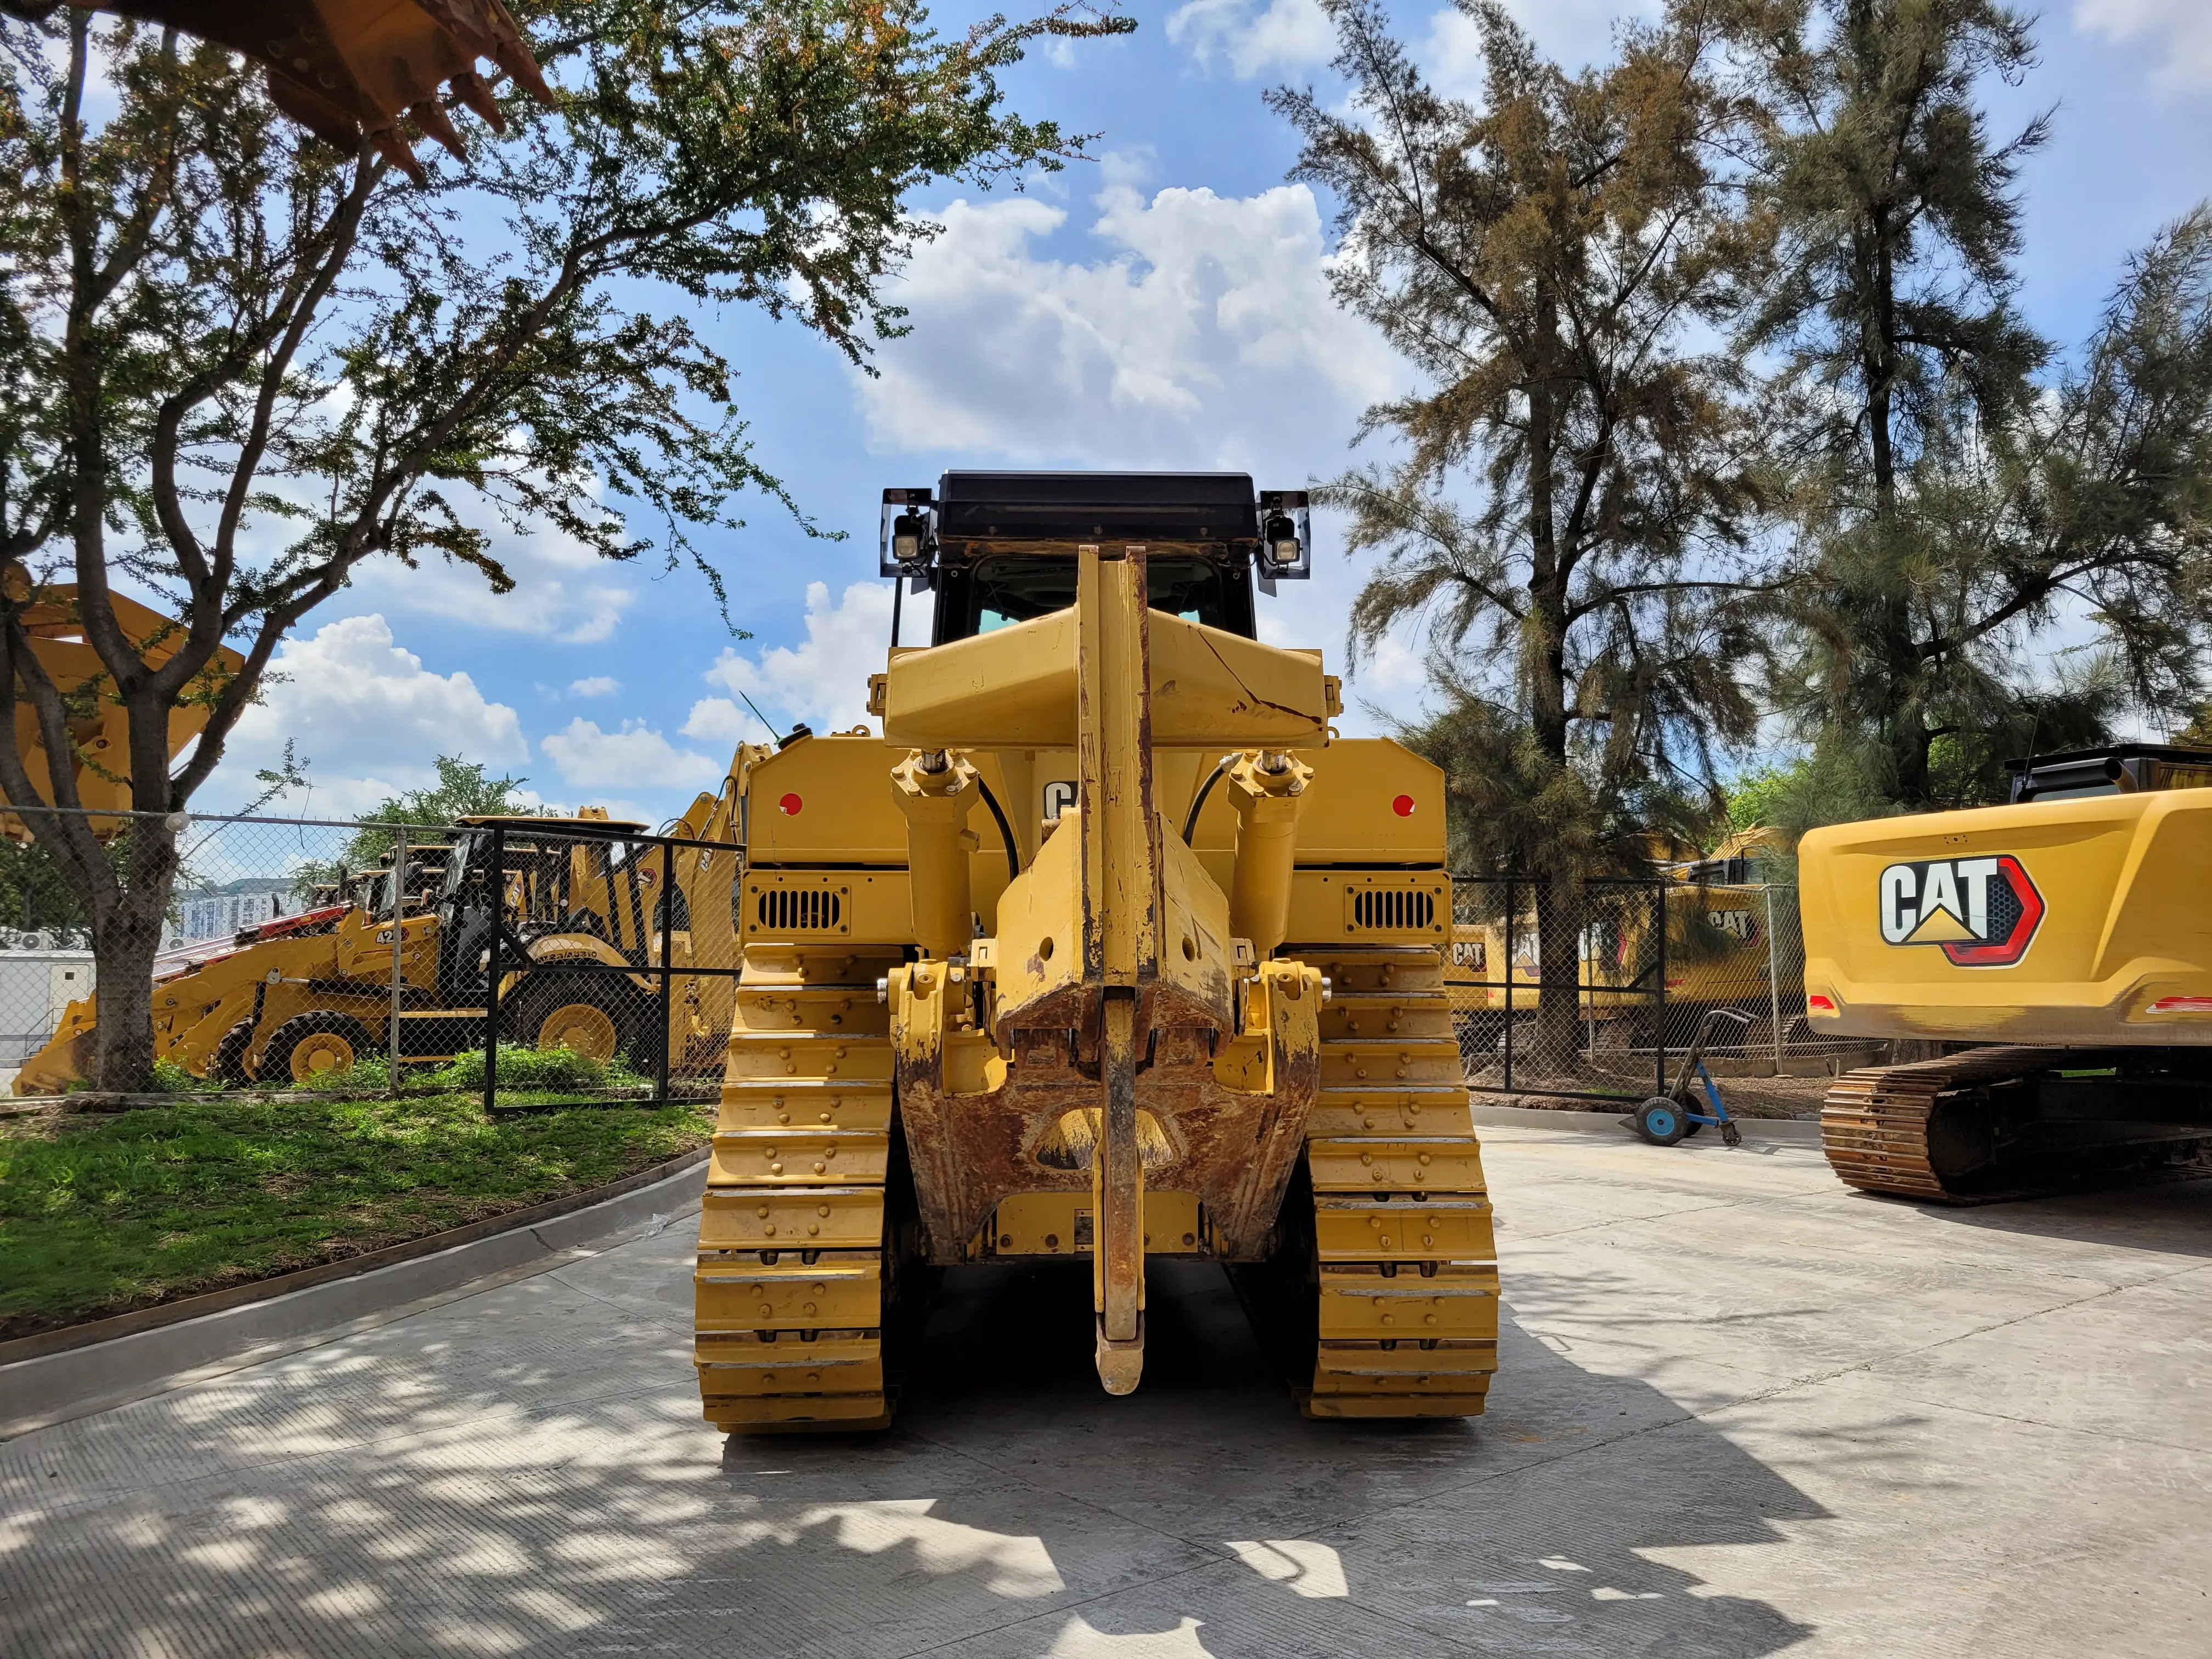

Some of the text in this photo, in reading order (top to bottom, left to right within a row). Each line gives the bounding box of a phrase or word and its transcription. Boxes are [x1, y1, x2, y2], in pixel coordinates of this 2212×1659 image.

[510, 883, 520, 906] CAT
[1881, 858, 1997, 943] CAT
[1707, 911, 1747, 939] CAT
[376, 930, 395, 944] 42
[1453, 943, 1481, 966] CAT
